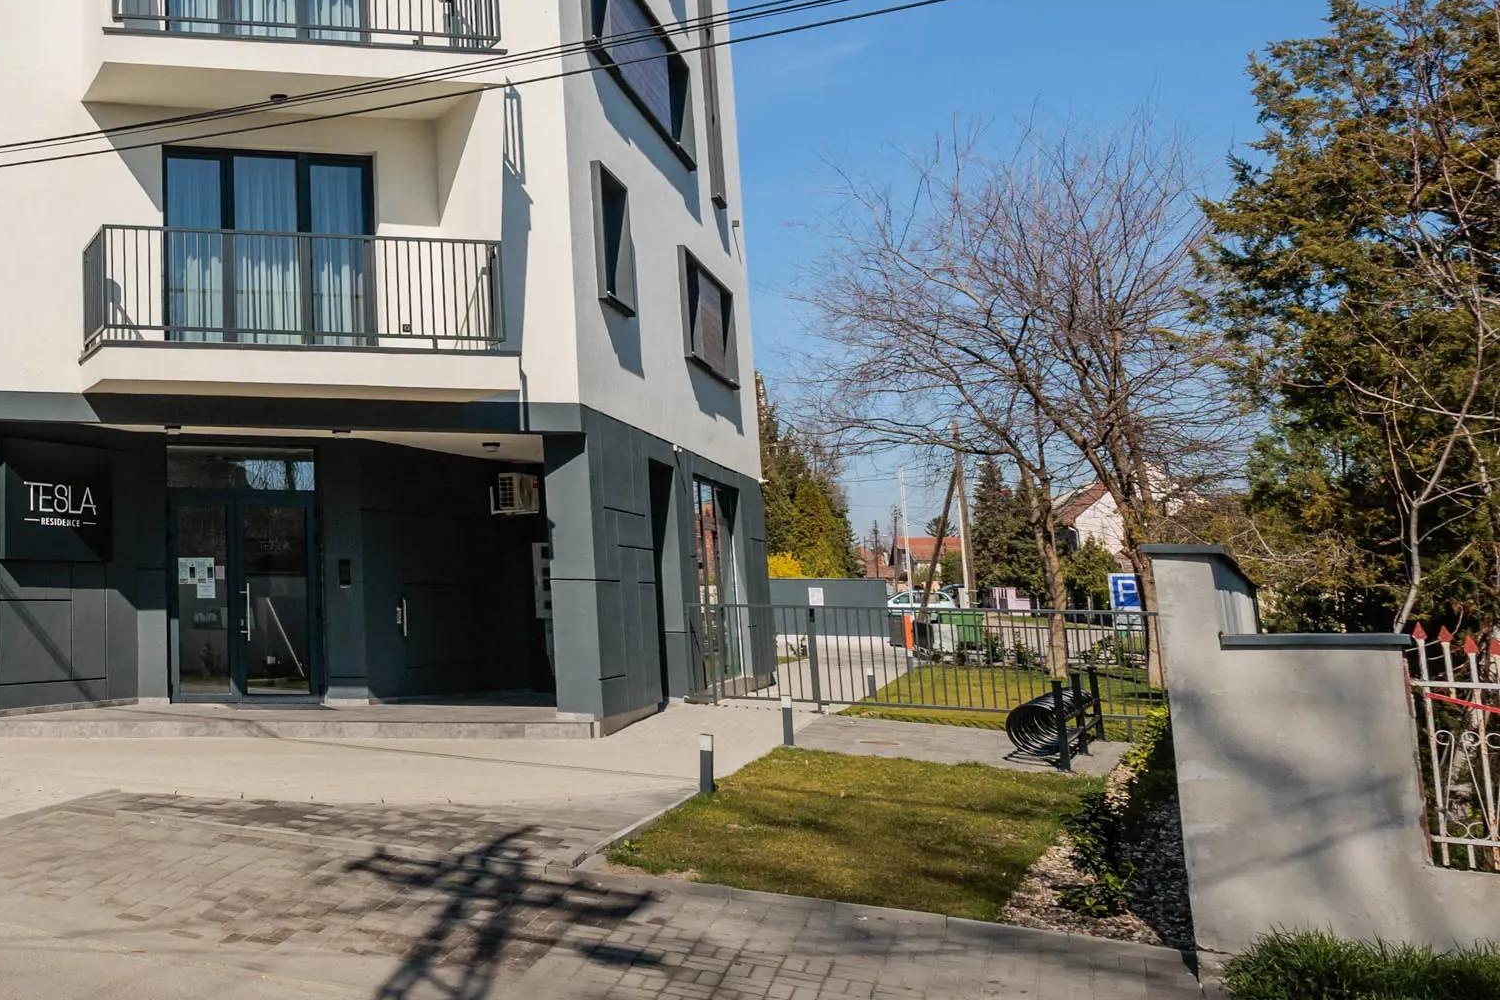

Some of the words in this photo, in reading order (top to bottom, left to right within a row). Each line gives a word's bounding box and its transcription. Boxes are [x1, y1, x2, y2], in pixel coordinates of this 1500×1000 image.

[23, 481, 97, 515] TESLA
[40, 517, 81, 527] RESIDENCE
[1117, 579, 1138, 602] P
